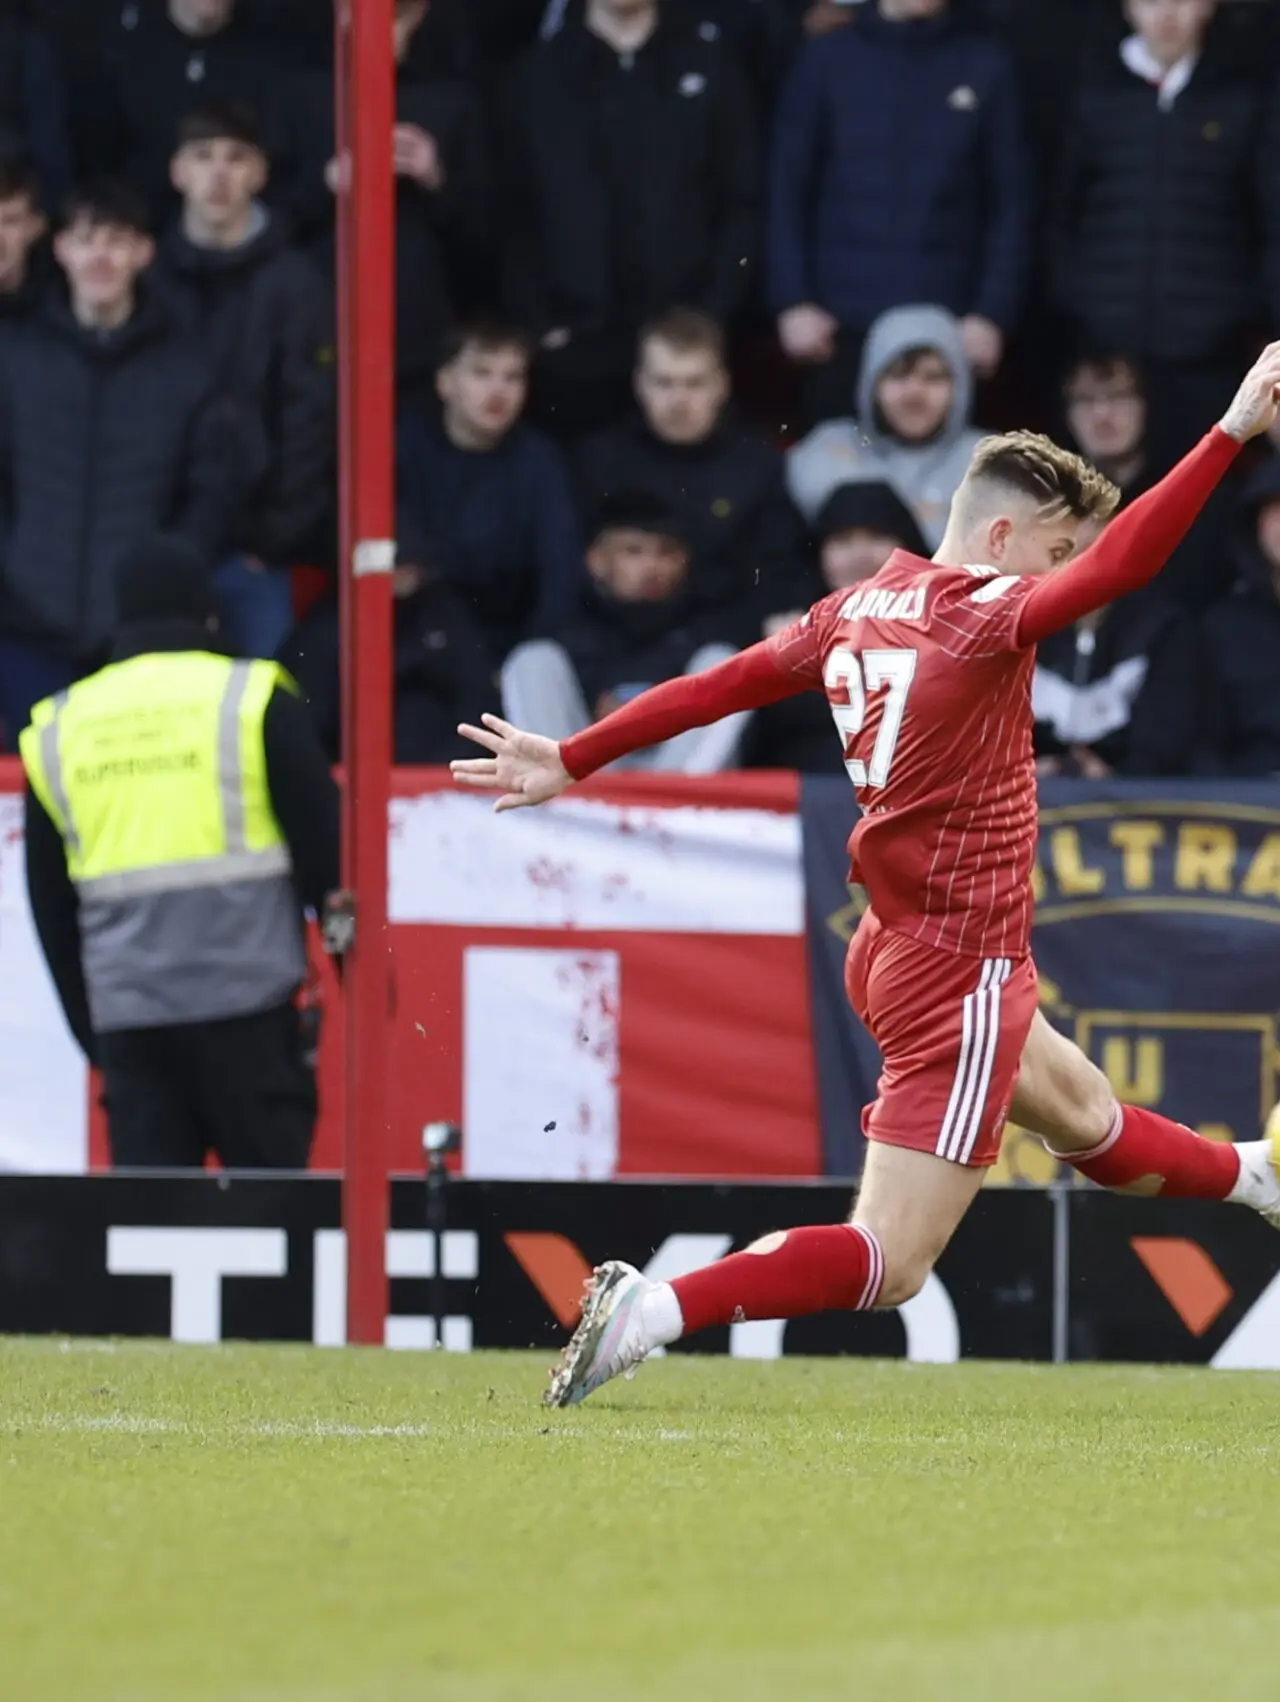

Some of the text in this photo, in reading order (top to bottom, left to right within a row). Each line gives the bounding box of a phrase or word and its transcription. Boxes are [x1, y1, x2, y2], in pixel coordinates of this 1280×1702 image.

[73, 750, 202, 786] SUPERVISOR
[822, 645, 918, 789] 27
[106, 1225, 960, 1363] TE
